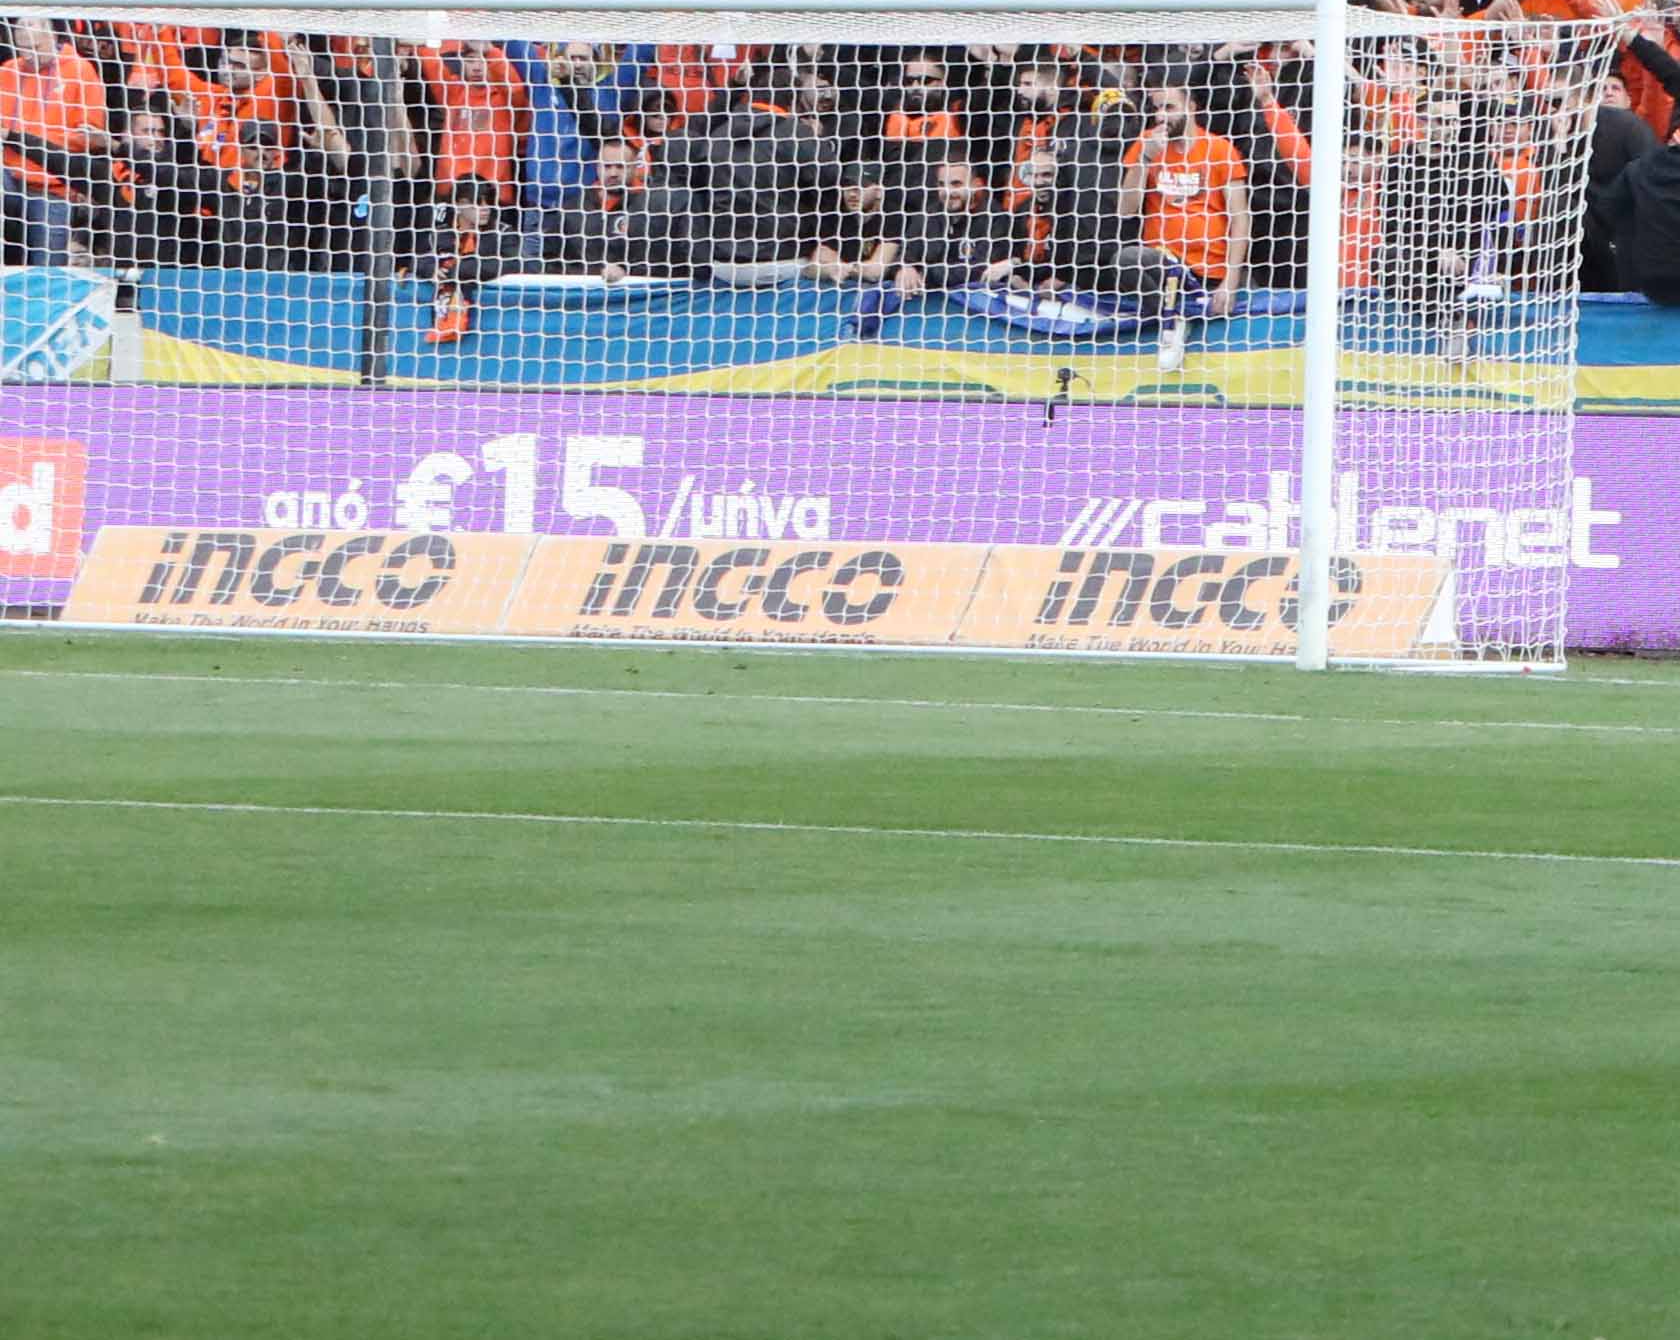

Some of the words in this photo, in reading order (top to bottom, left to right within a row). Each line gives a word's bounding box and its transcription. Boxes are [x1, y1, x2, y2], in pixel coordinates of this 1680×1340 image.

[264, 481, 369, 530] από
[398, 432, 645, 539] €15
[1143, 471, 1622, 569] cablenet
